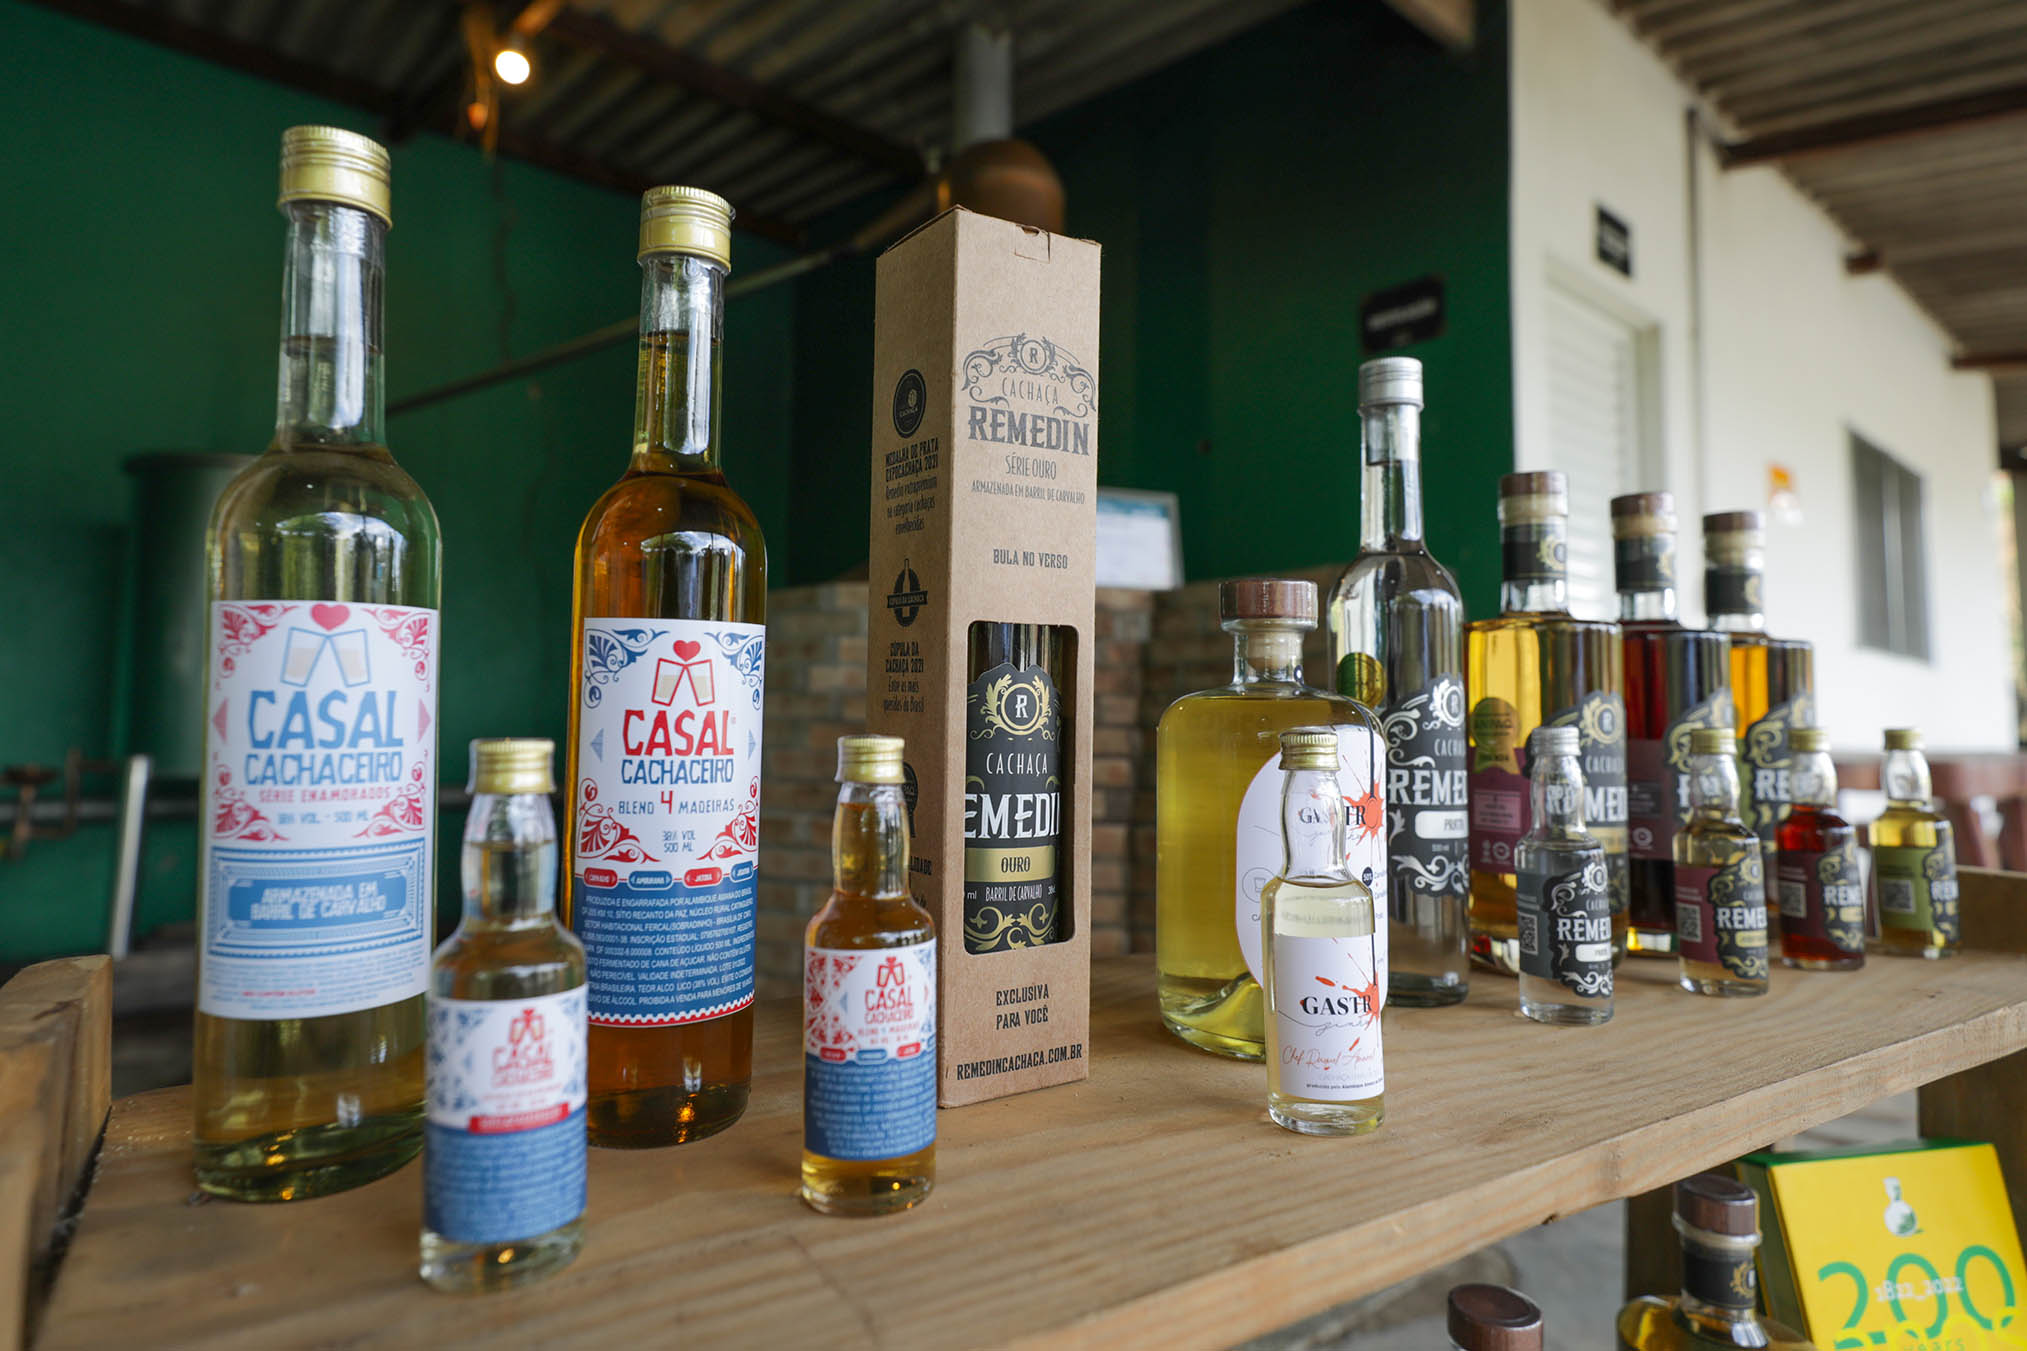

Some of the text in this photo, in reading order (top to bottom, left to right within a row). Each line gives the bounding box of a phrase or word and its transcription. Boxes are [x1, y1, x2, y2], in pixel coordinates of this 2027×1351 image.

[1002, 377, 1058, 405] CACHAÇA
[968, 404, 1090, 456] REMEDIN
[920, 437, 938, 457] PRATA
[1005, 452, 1057, 480] SÉRIE OURO
[971, 479, 1085, 505] ARMAZENADA EM BARRIL DE CARVALHO
[993, 548, 1068, 569] BULA NO VERSO
[1015, 694, 1028, 718] R
[248, 689, 404, 750] CASAL
[622, 709, 734, 757] CASAL
[244, 752, 402, 786] CACHACEIRO
[621, 759, 734, 785] CACHACEIRO
[986, 752, 1048, 777] CACHAÇA
[619, 790, 735, 815] BLEND 4 MADEIRAS
[965, 792, 1060, 839] EMEDI
[1000, 856, 1031, 874] OURO
[985, 887, 1008, 902] BARRIL
[1008, 886, 1017, 901] DE
[1017, 883, 1043, 900] CARVALHO
[864, 988, 914, 1012] CASAL
[996, 984, 1049, 1007] EXCLUSIVA
[996, 1005, 1049, 1030] PARA VOCÊ
[956, 1043, 1083, 1081] REMEDINCACHACA.COM.BR
[1818, 1245, 2015, 1350] 200
